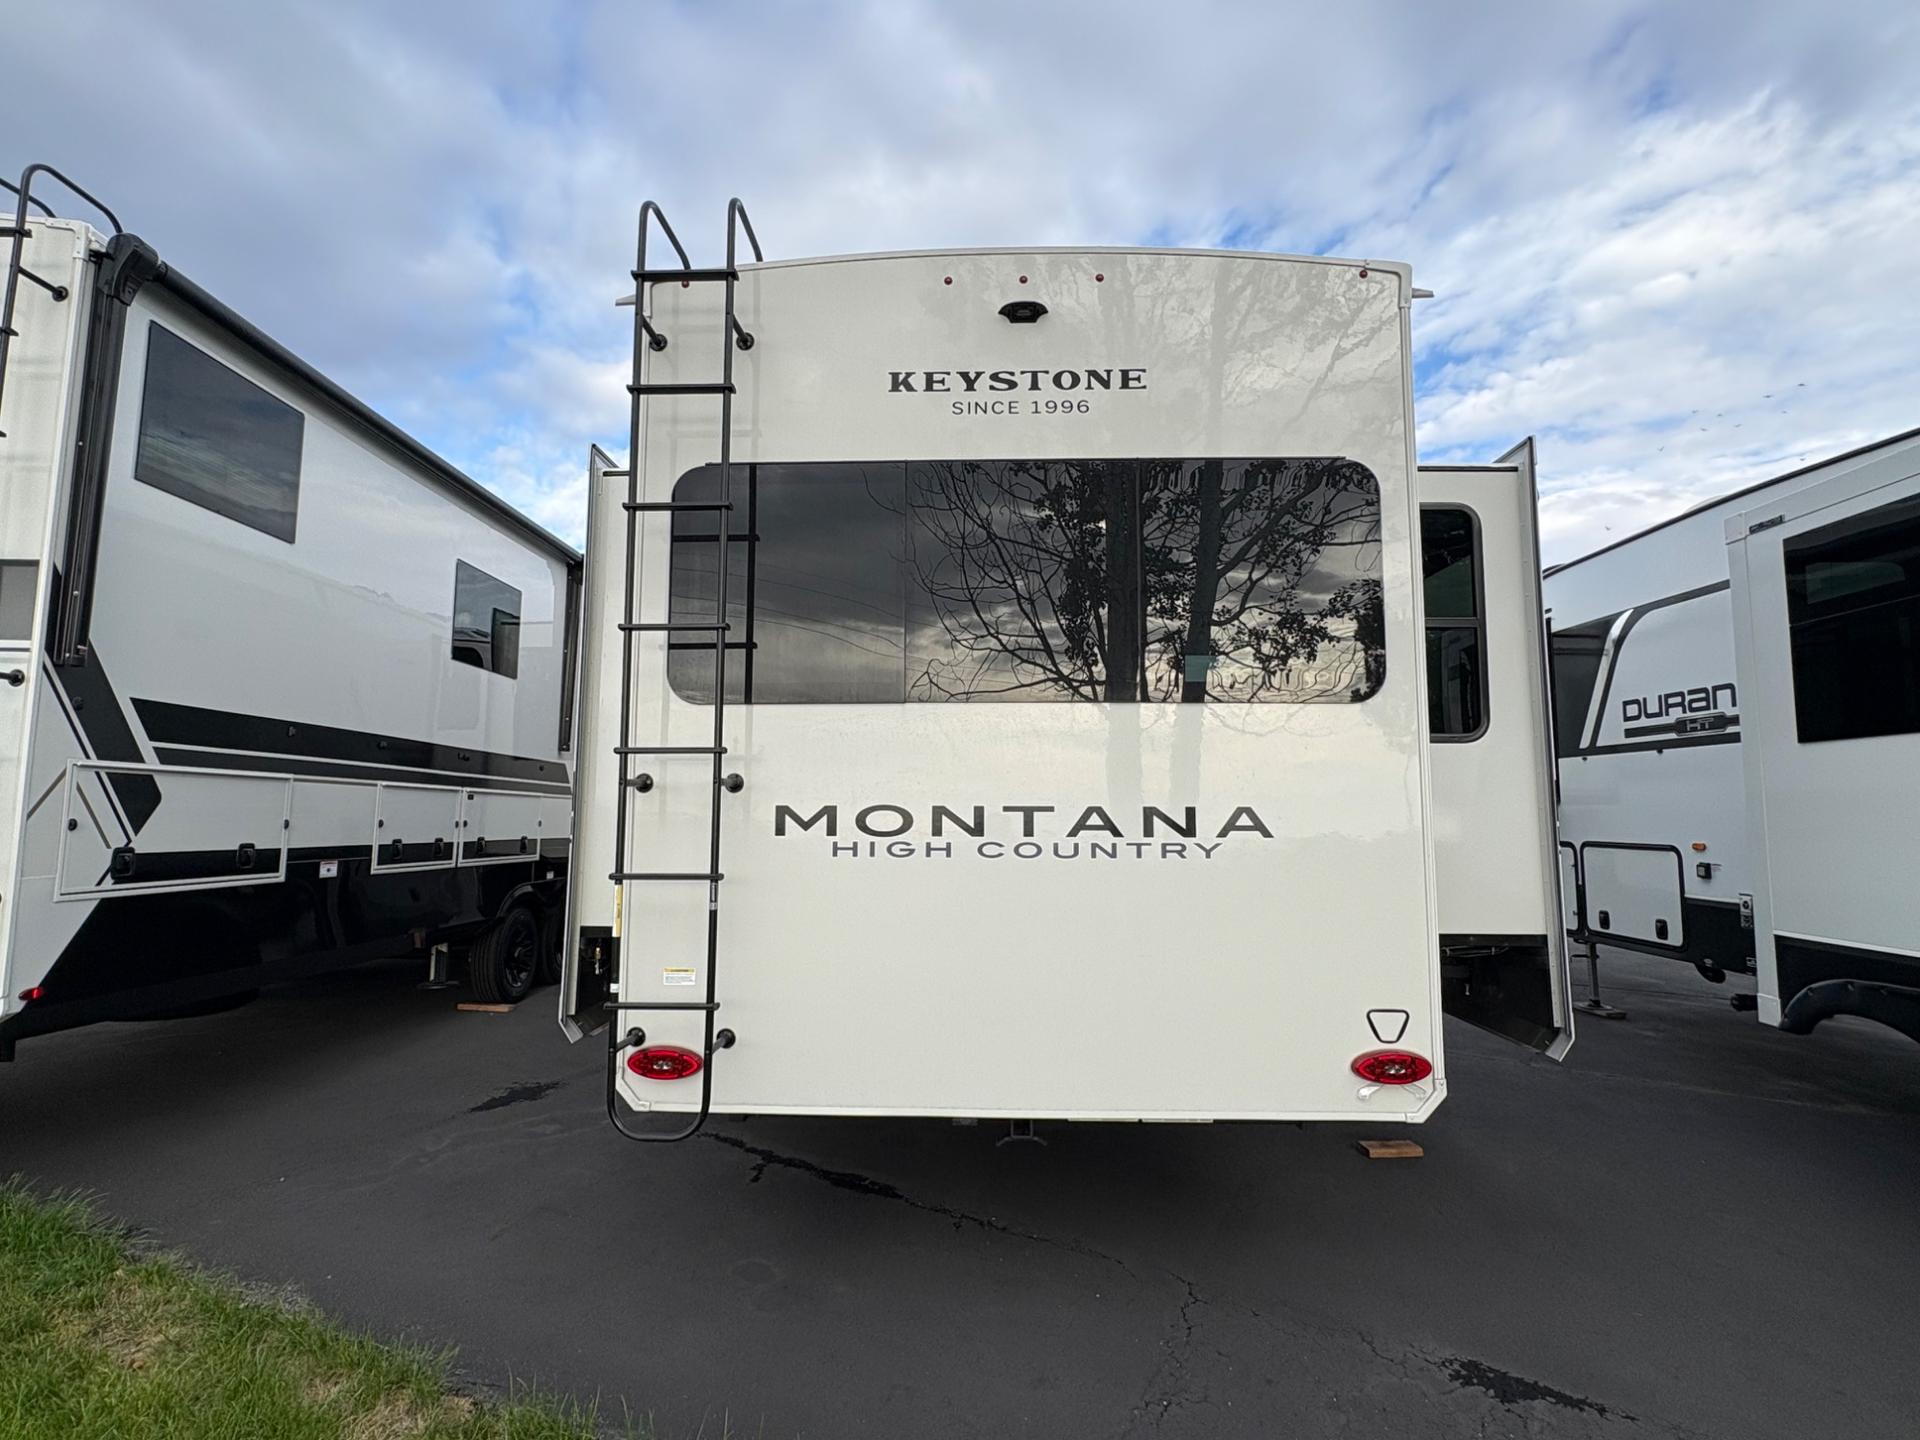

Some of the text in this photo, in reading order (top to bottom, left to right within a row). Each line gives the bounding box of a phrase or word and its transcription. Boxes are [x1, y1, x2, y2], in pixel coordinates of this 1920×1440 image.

[888, 368, 1147, 393] KEYSTONE
[951, 400, 1090, 415] SINCE 1996
[1686, 717, 1715, 731] HT
[774, 804, 1274, 838] MONTANA
[832, 841, 1223, 859] HIGH COUNTRY
